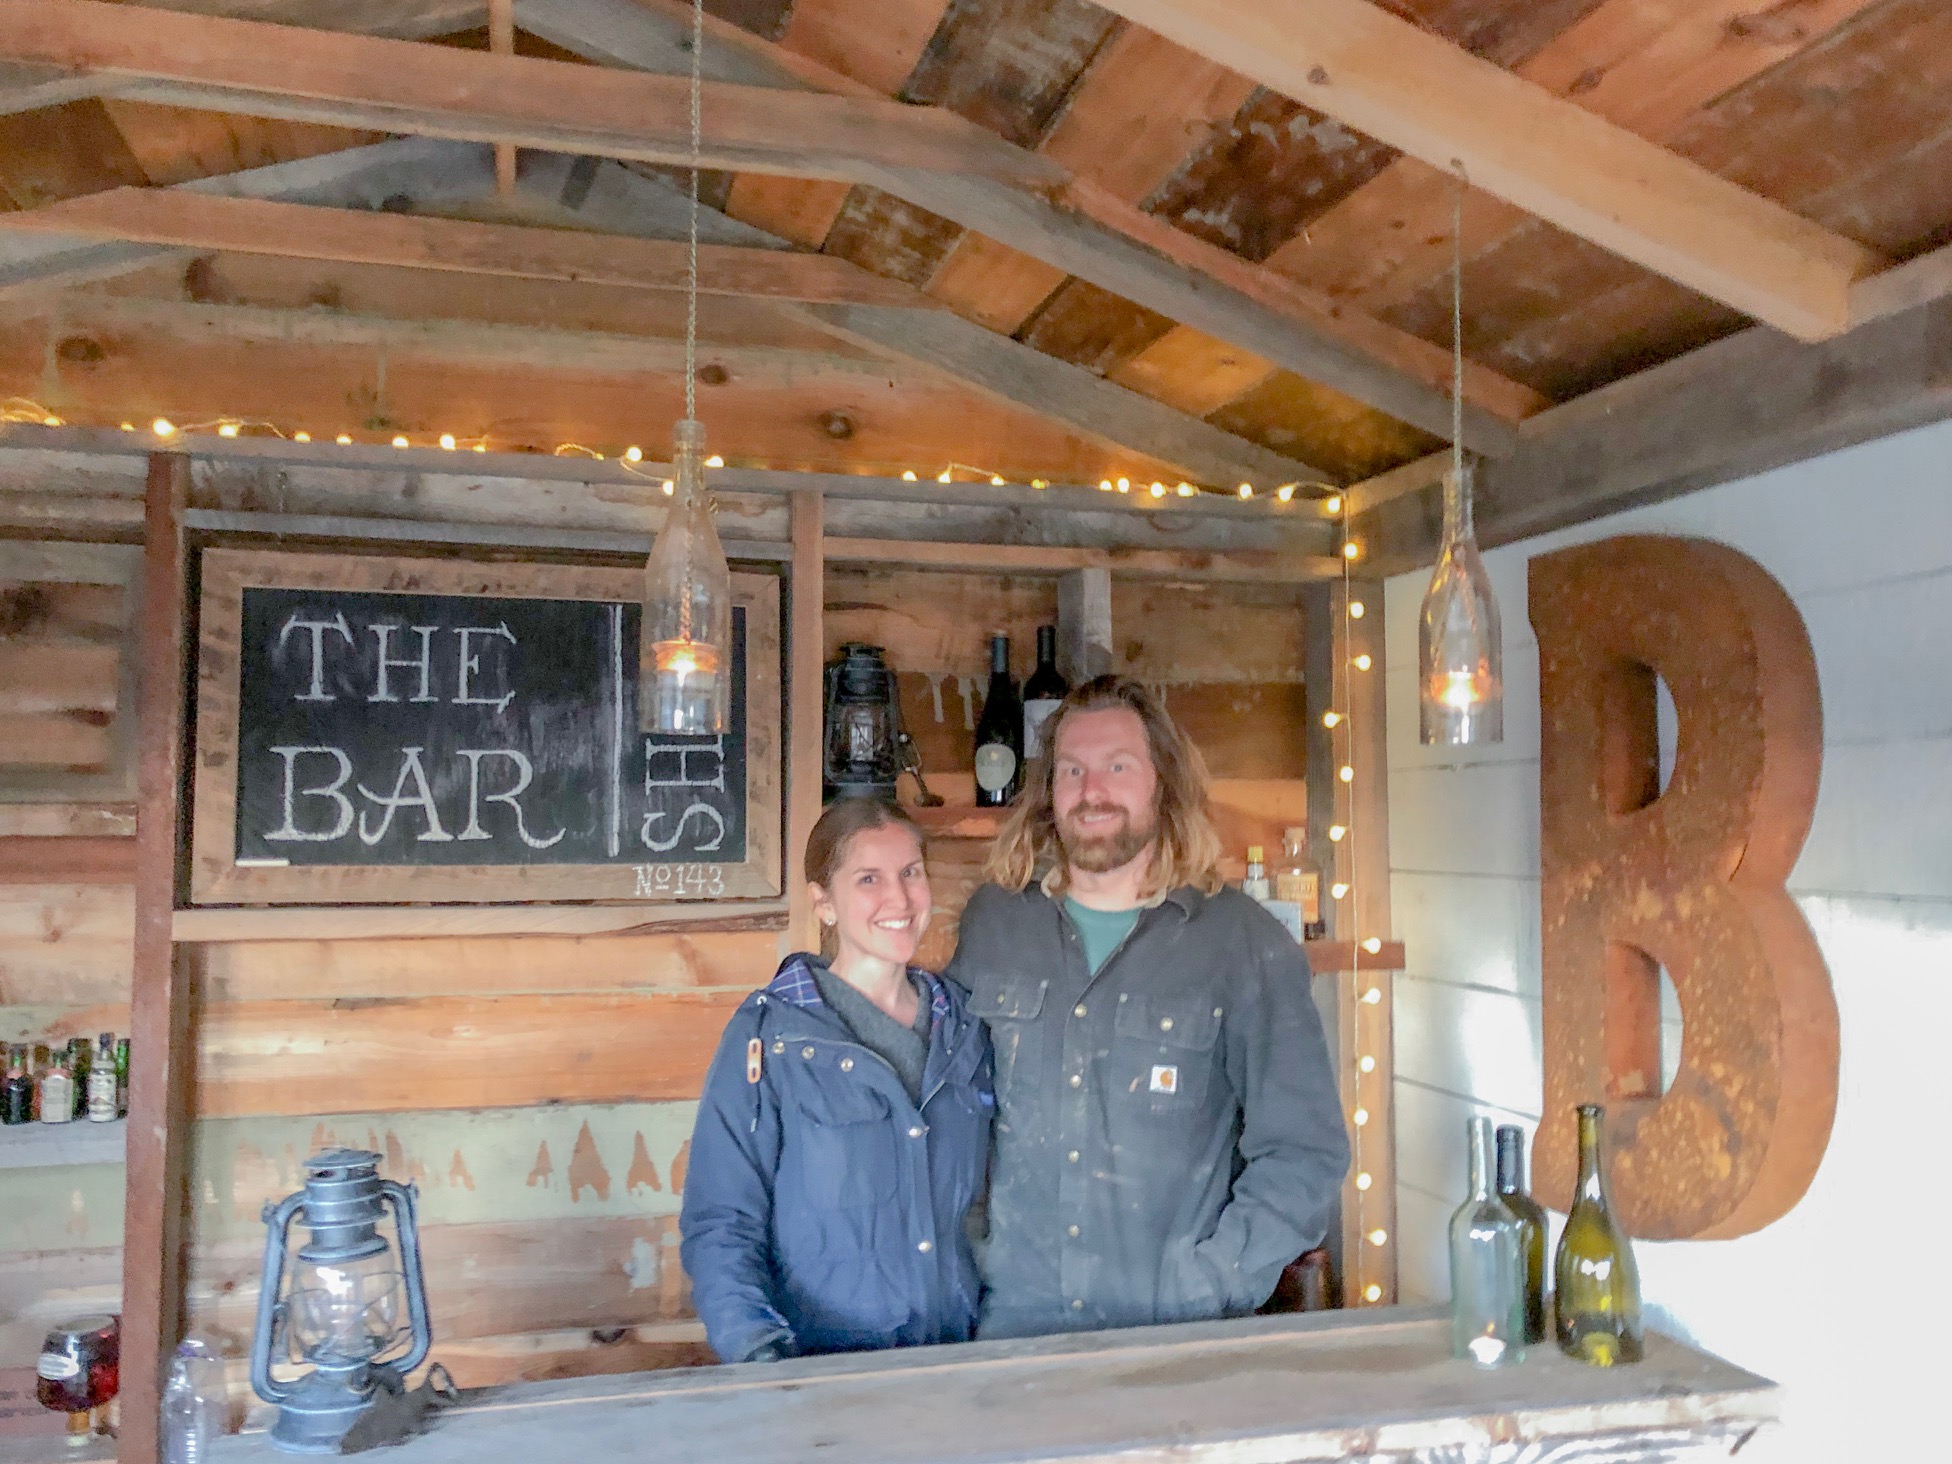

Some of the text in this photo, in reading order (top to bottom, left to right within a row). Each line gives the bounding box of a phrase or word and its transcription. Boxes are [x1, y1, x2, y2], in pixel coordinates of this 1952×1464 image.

[279, 610, 517, 714] THE
[263, 745, 567, 849] BAR
[641, 733, 725, 852] SH
[1528, 532, 1840, 1242] B
